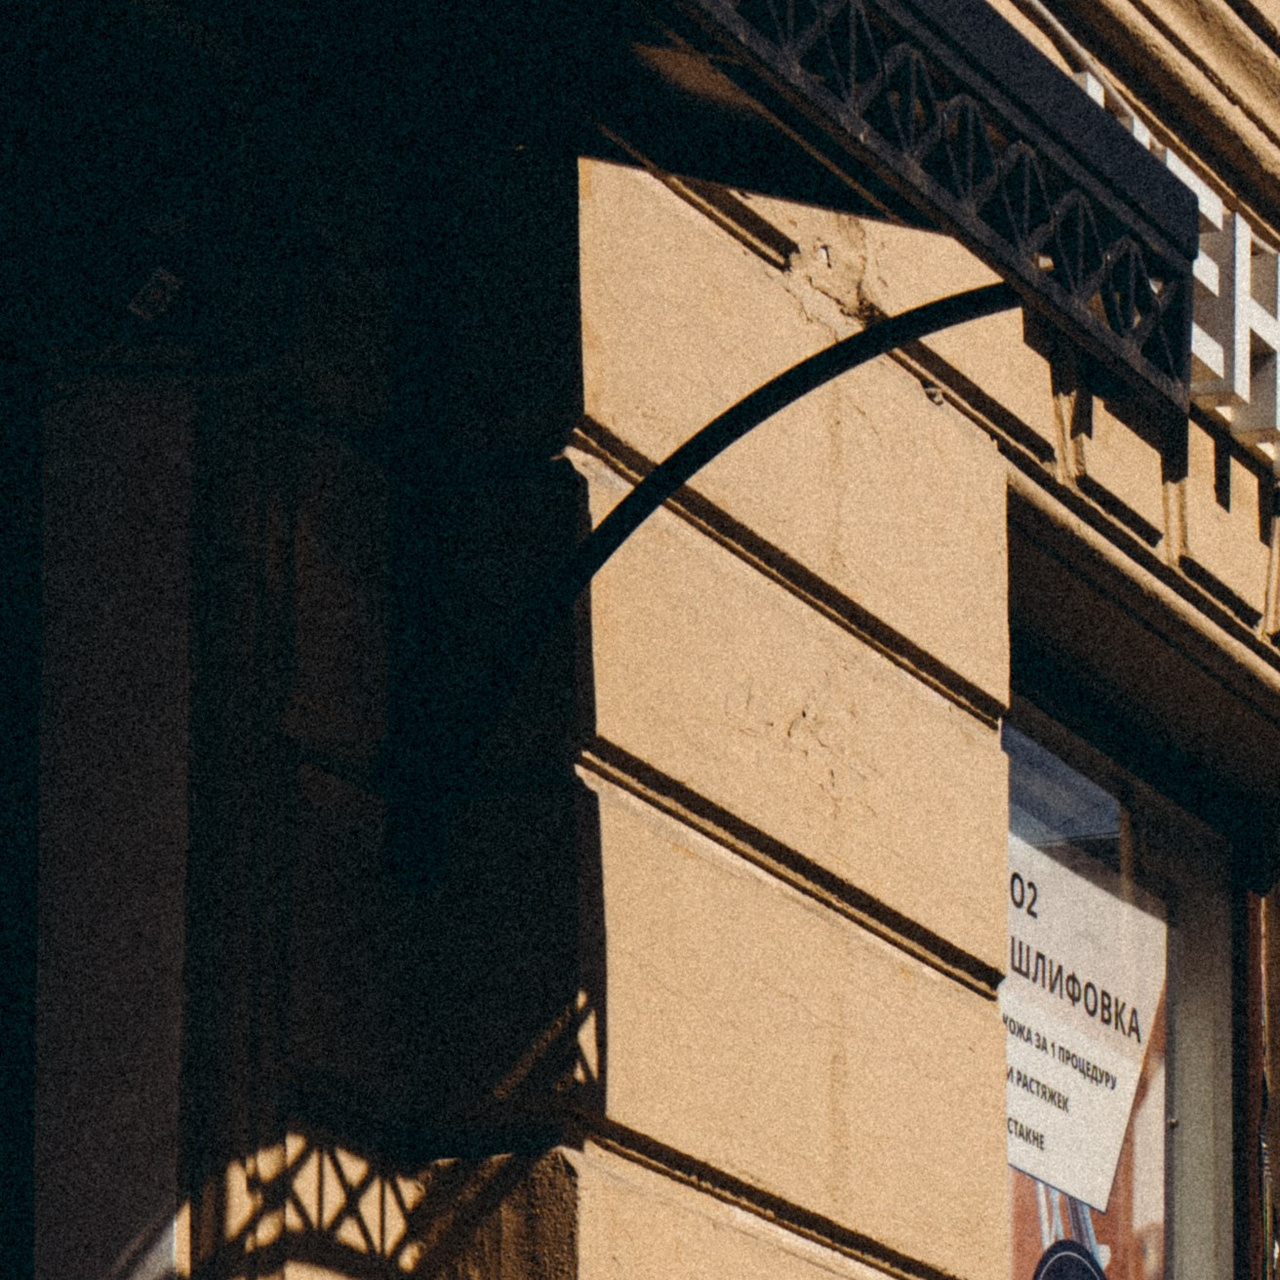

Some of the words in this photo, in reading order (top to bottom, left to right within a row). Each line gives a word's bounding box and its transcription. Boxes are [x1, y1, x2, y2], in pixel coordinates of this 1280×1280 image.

[1010, 935, 1142, 1044] ШЛИФОВКА
[1034, 1032, 1049, 1056] ЗА
[1050, 1042, 1056, 1059] 1
[1057, 1045, 1118, 1091] ПРОЦЕДУРУ
[1016, 1070, 1069, 1113] РАСТЯЖЕК
